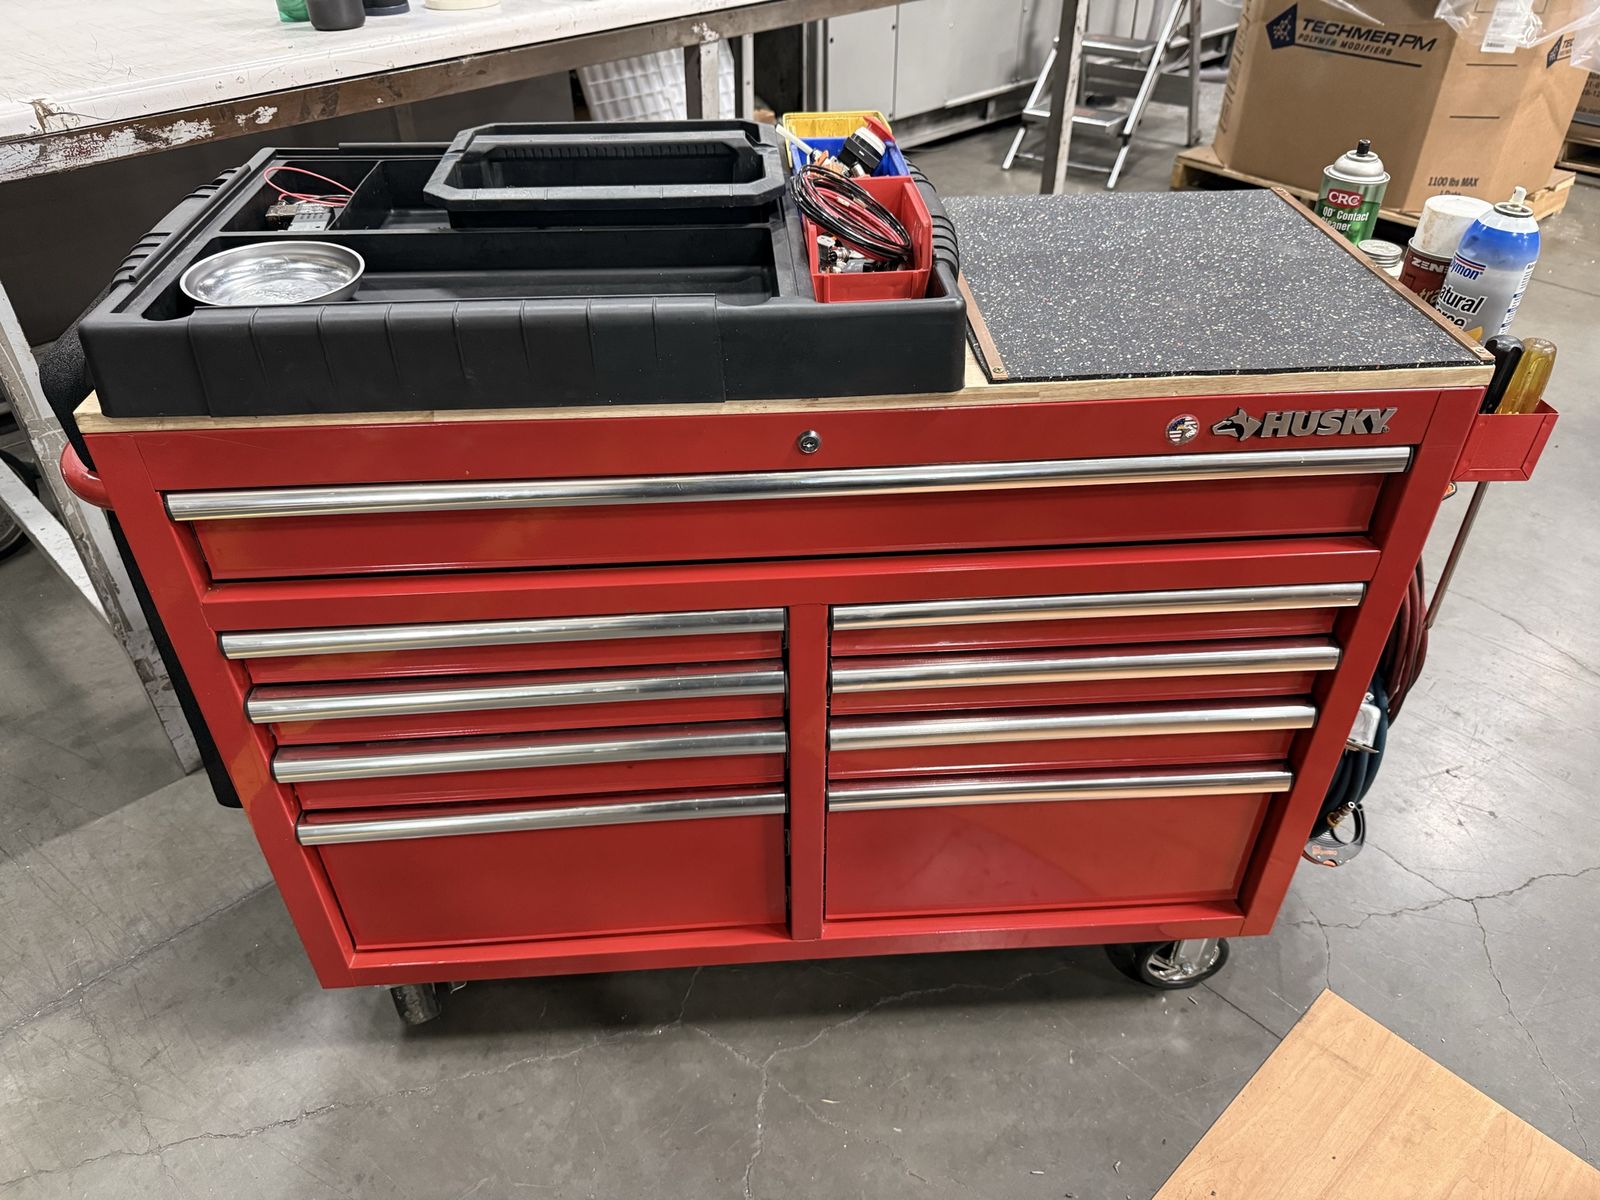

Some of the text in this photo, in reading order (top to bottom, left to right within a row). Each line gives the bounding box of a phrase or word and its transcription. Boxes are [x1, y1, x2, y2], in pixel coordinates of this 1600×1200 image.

[1340, 42, 1393, 56] MODIFIERS
[1428, 176, 1448, 187] 1100
[1461, 176, 1479, 187] MAX
[1328, 191, 1361, 206] CRC
[1337, 210, 1369, 221] Contact
[1450, 261, 1480, 281] ymon
[1440, 285, 1486, 314] atural
[1260, 407, 1398, 438] HUSKY
